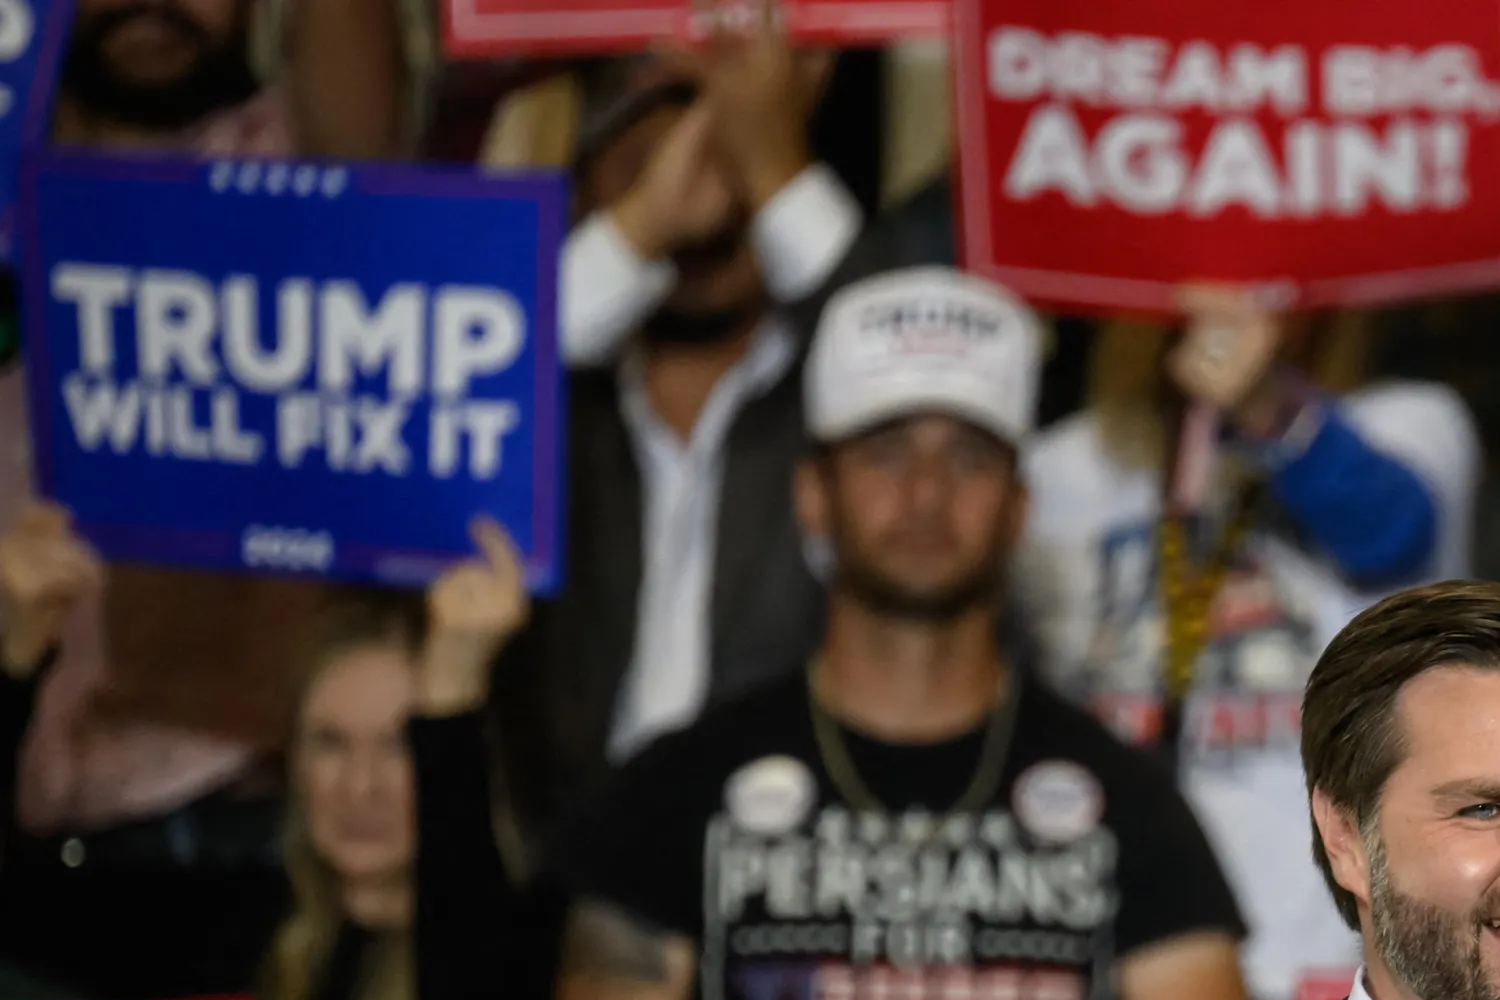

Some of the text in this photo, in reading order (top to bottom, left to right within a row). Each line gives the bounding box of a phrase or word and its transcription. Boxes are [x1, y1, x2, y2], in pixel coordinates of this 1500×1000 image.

[987, 25, 1309, 117] DREAM
[1005, 105, 1470, 220] AGAIN!
[50, 262, 527, 399] TRUMP
[62, 376, 520, 481] WILL FIX IT
[718, 842, 1115, 930] PERSIANS
[852, 914, 974, 965] FOR
